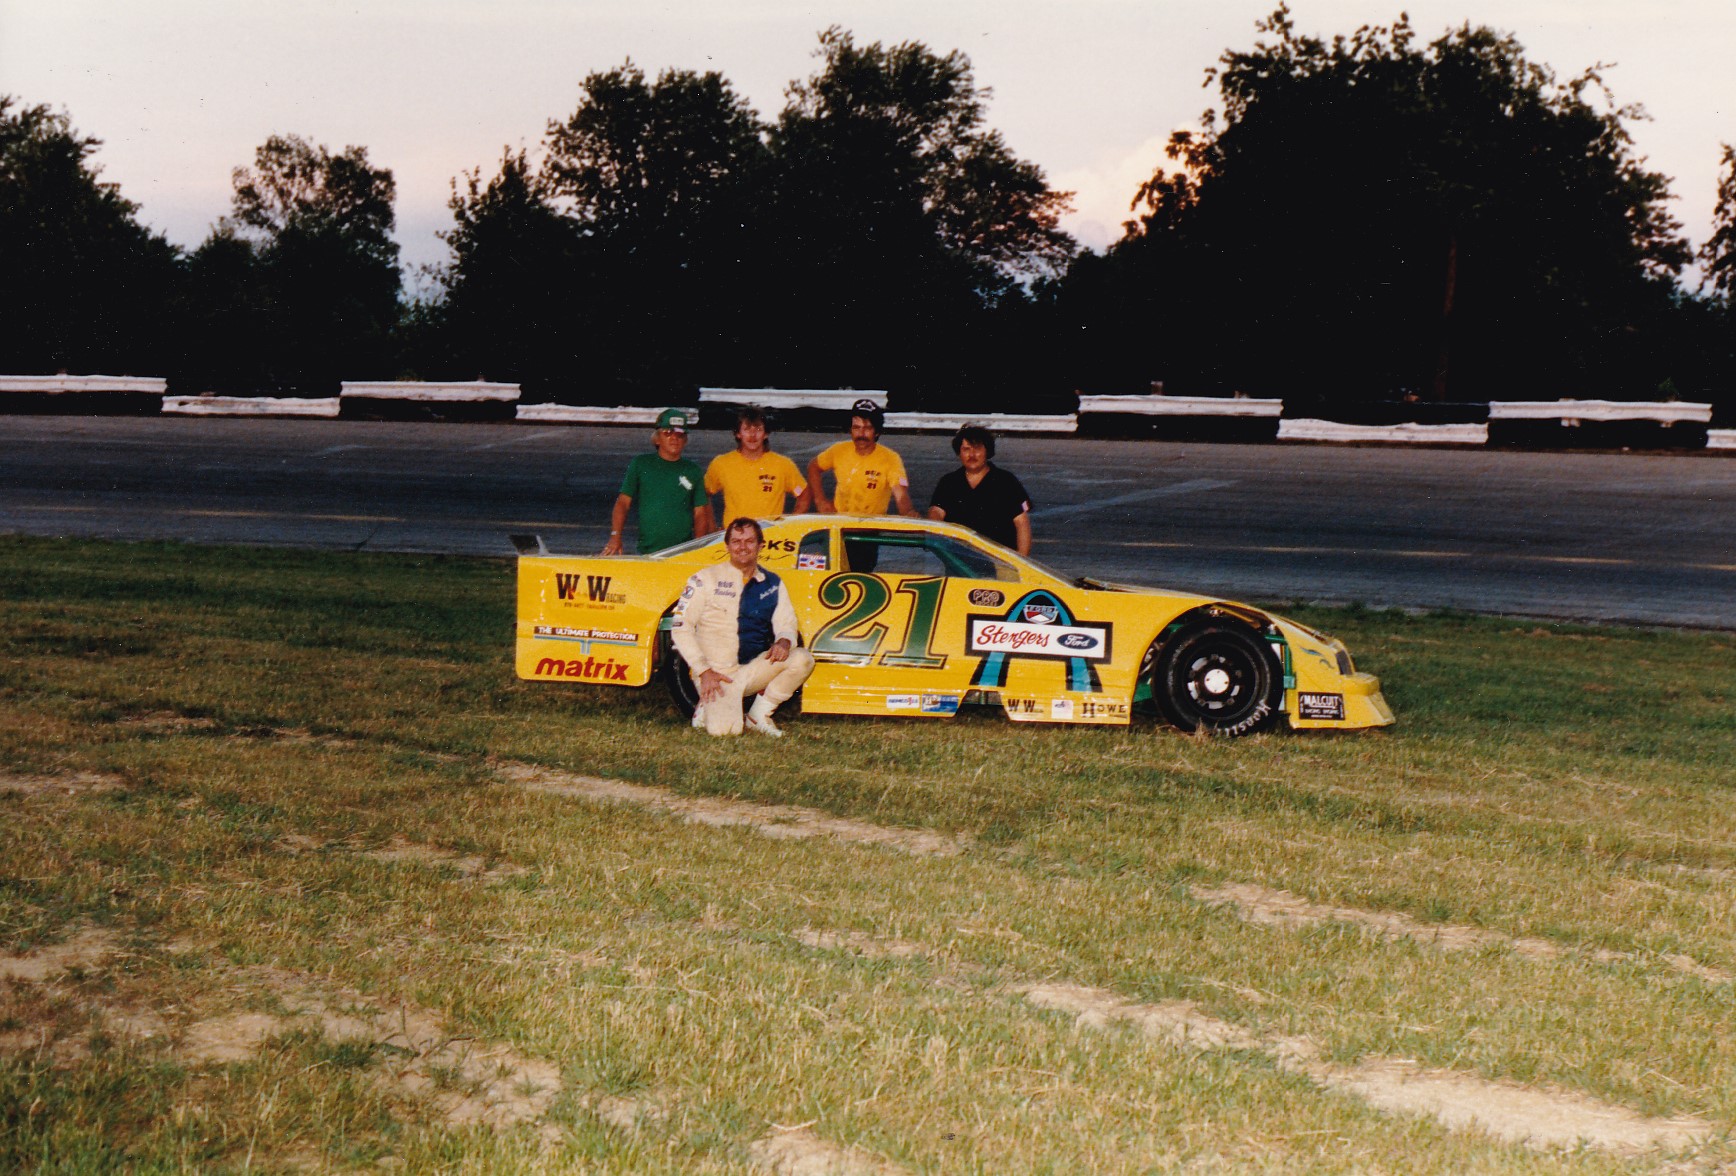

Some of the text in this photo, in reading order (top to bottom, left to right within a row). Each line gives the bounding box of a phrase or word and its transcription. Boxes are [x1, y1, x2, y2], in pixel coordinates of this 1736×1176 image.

[972, 589, 1000, 602] PRO
[809, 571, 948, 669] 21
[538, 626, 636, 641] THE ULTIMATE PROTECTION
[976, 624, 1091, 649] Stengers Ford
[535, 657, 629, 681] matrix
